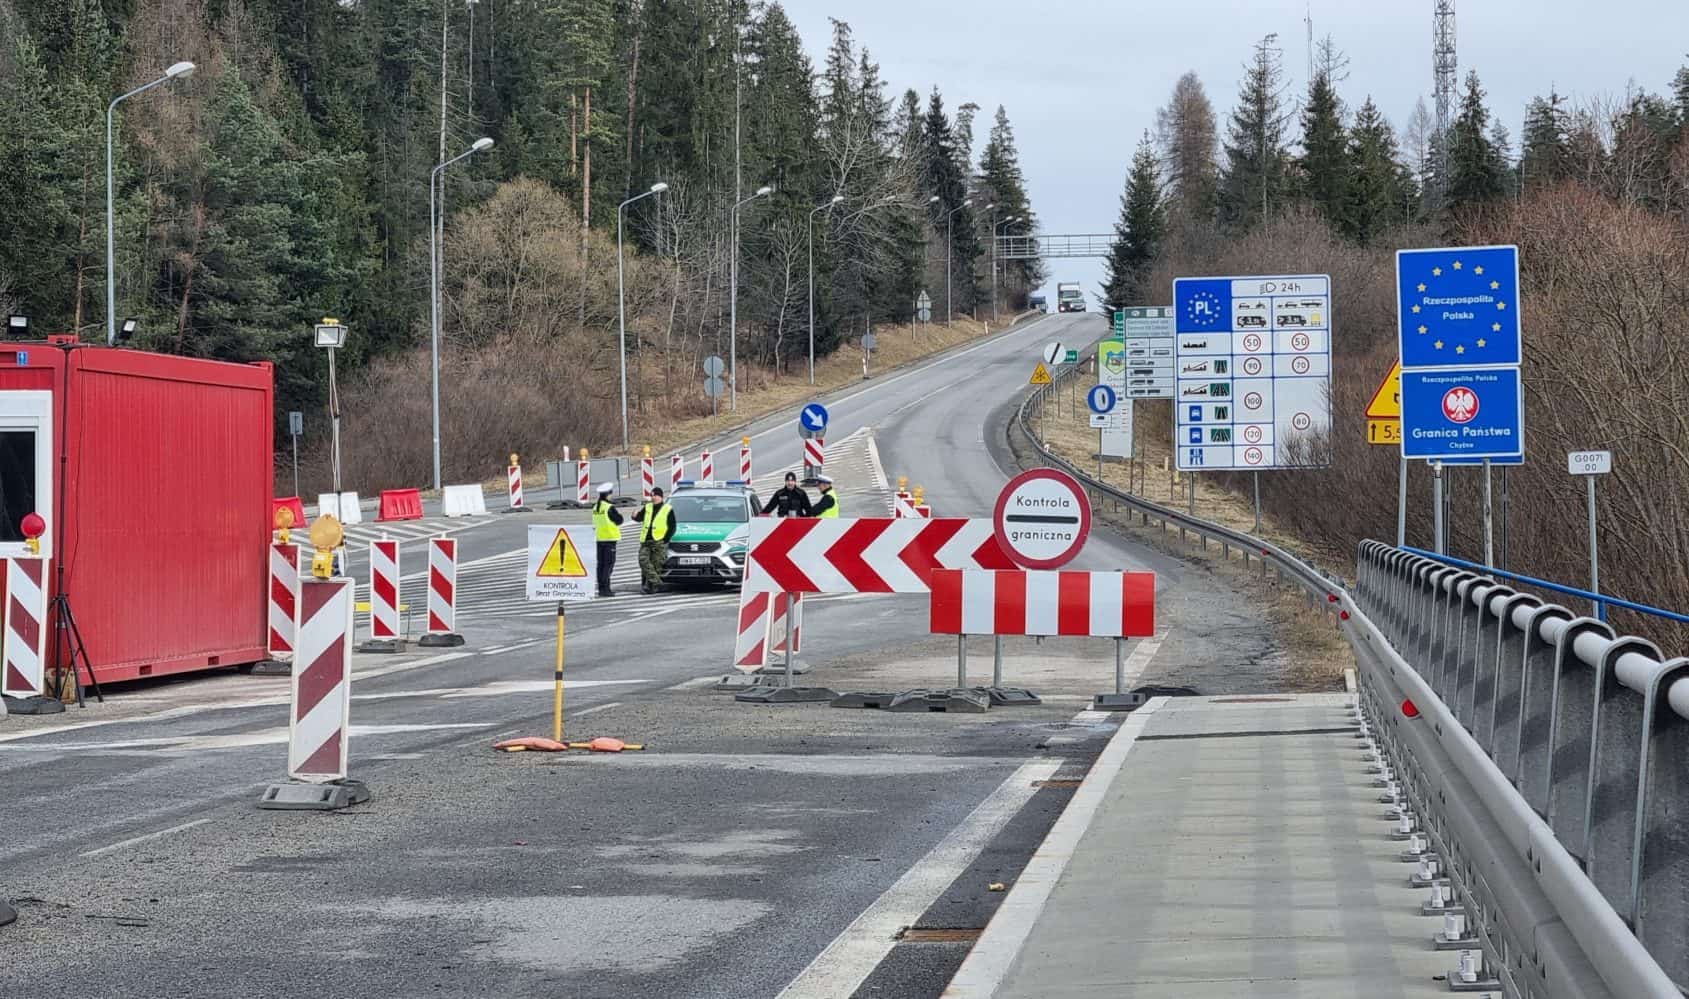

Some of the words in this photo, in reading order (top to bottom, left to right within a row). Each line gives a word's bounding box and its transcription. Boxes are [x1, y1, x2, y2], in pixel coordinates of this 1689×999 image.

[1281, 282, 1301, 292] 24h
[1423, 294, 1494, 306] Rzeczpospolita
[1195, 301, 1212, 315] PL
[1442, 311, 1474, 320] Polska
[1246, 338, 1259, 347] 50
[1295, 337, 1307, 346] 50
[1475, 374, 1498, 382] Polska
[1247, 397, 1260, 405] 100
[1247, 430, 1260, 438] 120
[1412, 427, 1458, 439] Granica
[1463, 426, 1511, 437] Państwa
[1247, 452, 1260, 460] 140
[1574, 454, 1603, 463] G0071
[1585, 463, 1597, 471] 00
[1016, 495, 1070, 508] Kontrola
[1011, 528, 1072, 542] graniczna
[543, 582, 578, 590] KONTROLA
